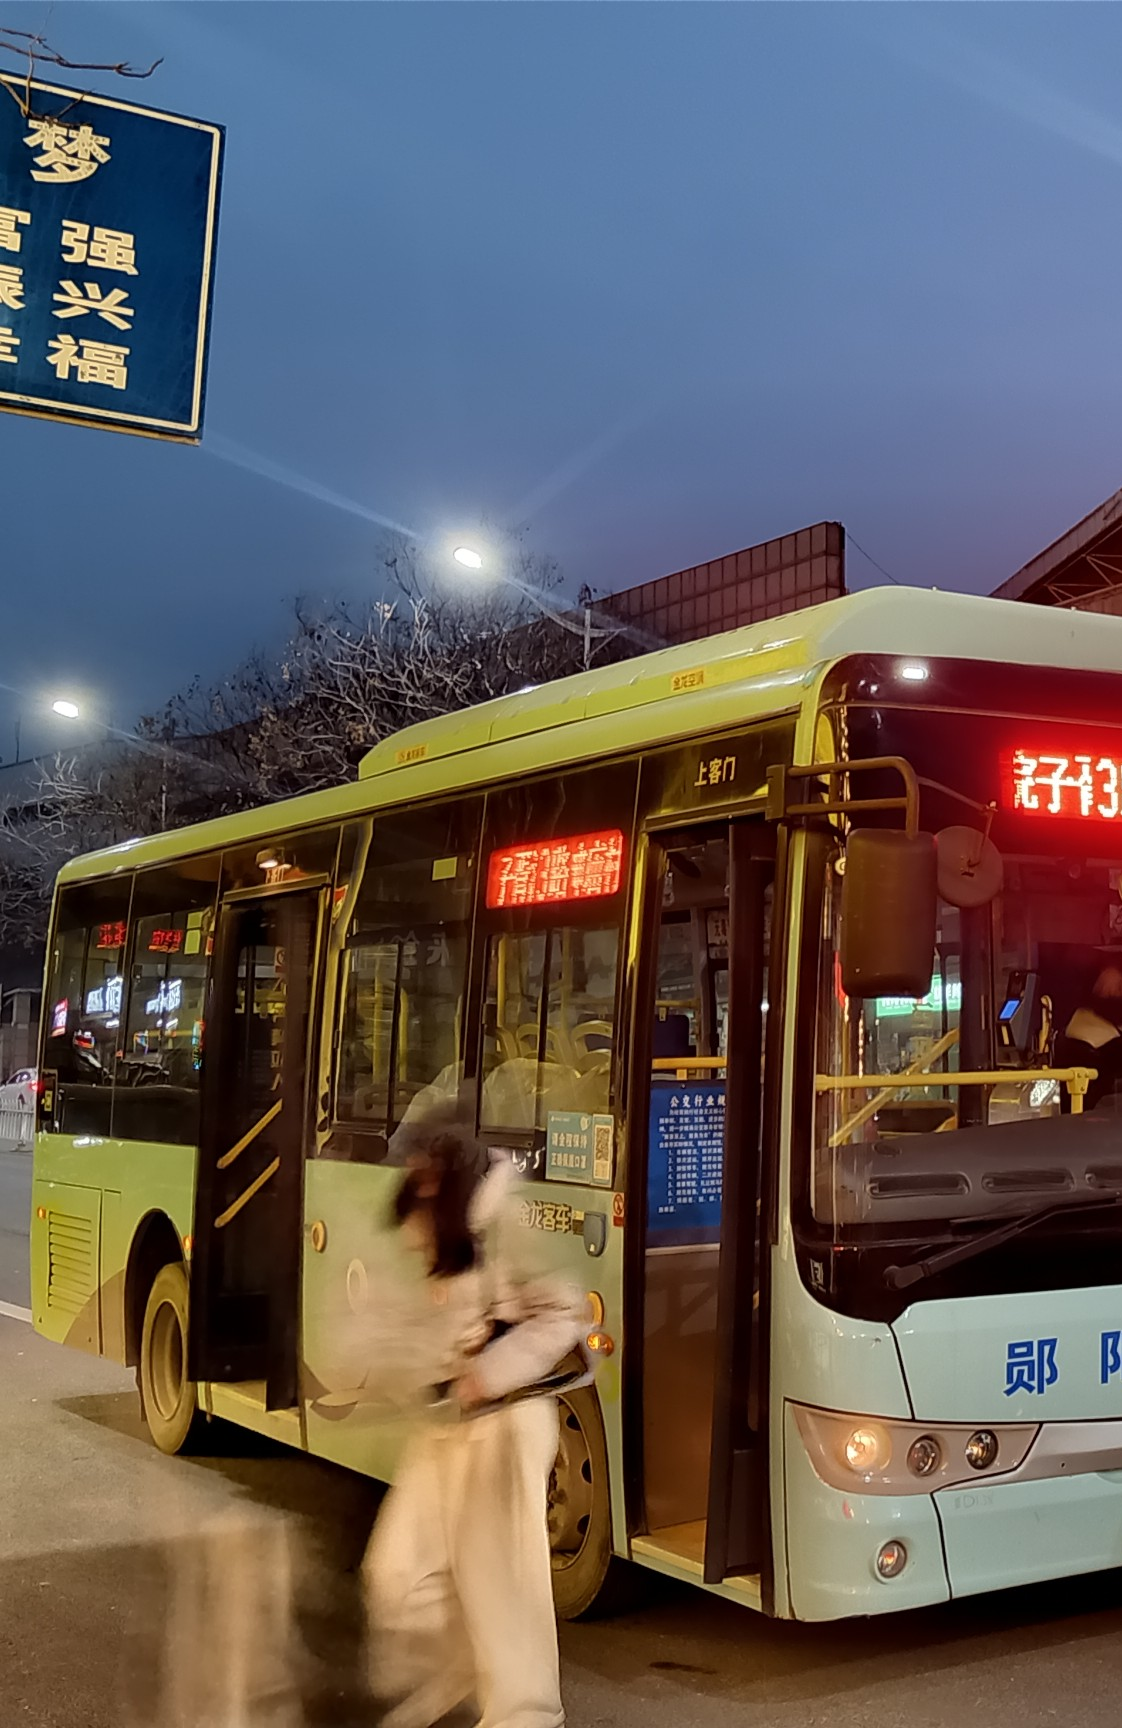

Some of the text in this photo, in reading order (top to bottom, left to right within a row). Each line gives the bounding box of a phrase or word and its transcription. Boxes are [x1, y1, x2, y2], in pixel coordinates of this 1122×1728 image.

[23, 118, 111, 184] 梦
[694, 756, 736, 786] 上客门
